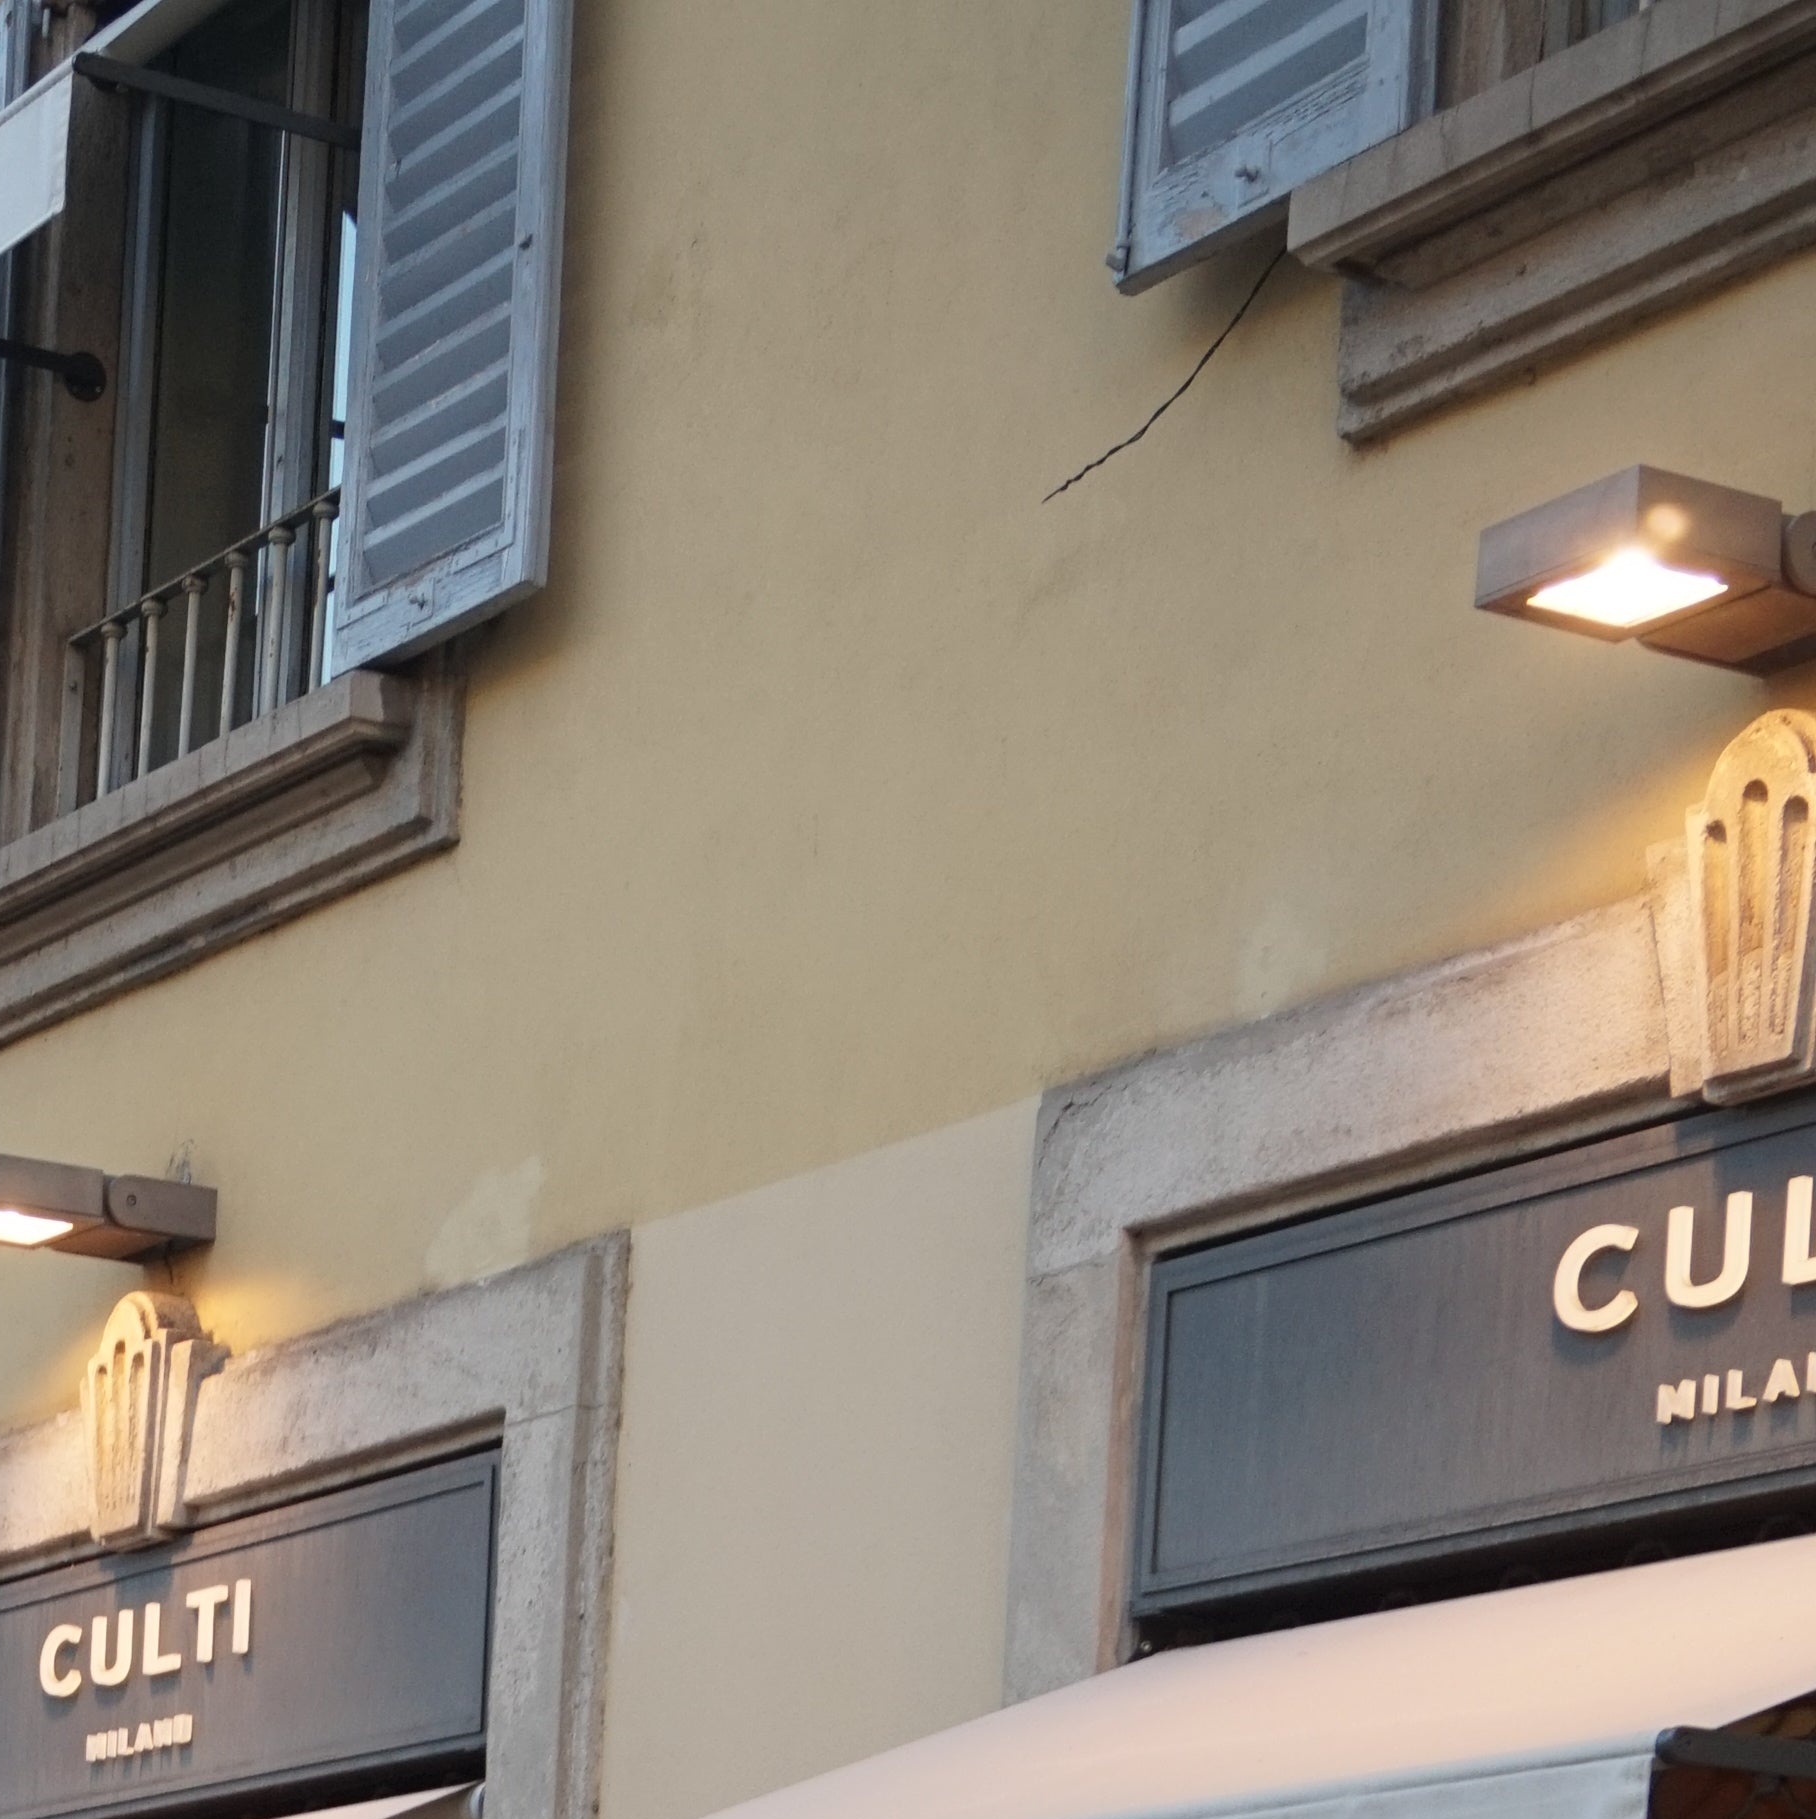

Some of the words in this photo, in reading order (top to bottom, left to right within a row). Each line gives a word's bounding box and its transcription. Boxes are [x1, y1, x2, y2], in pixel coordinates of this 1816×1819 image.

[1656, 1351, 1816, 1425] MILA
[39, 1578, 253, 1698] CULTI
[85, 1713, 194, 1762] MILANO
